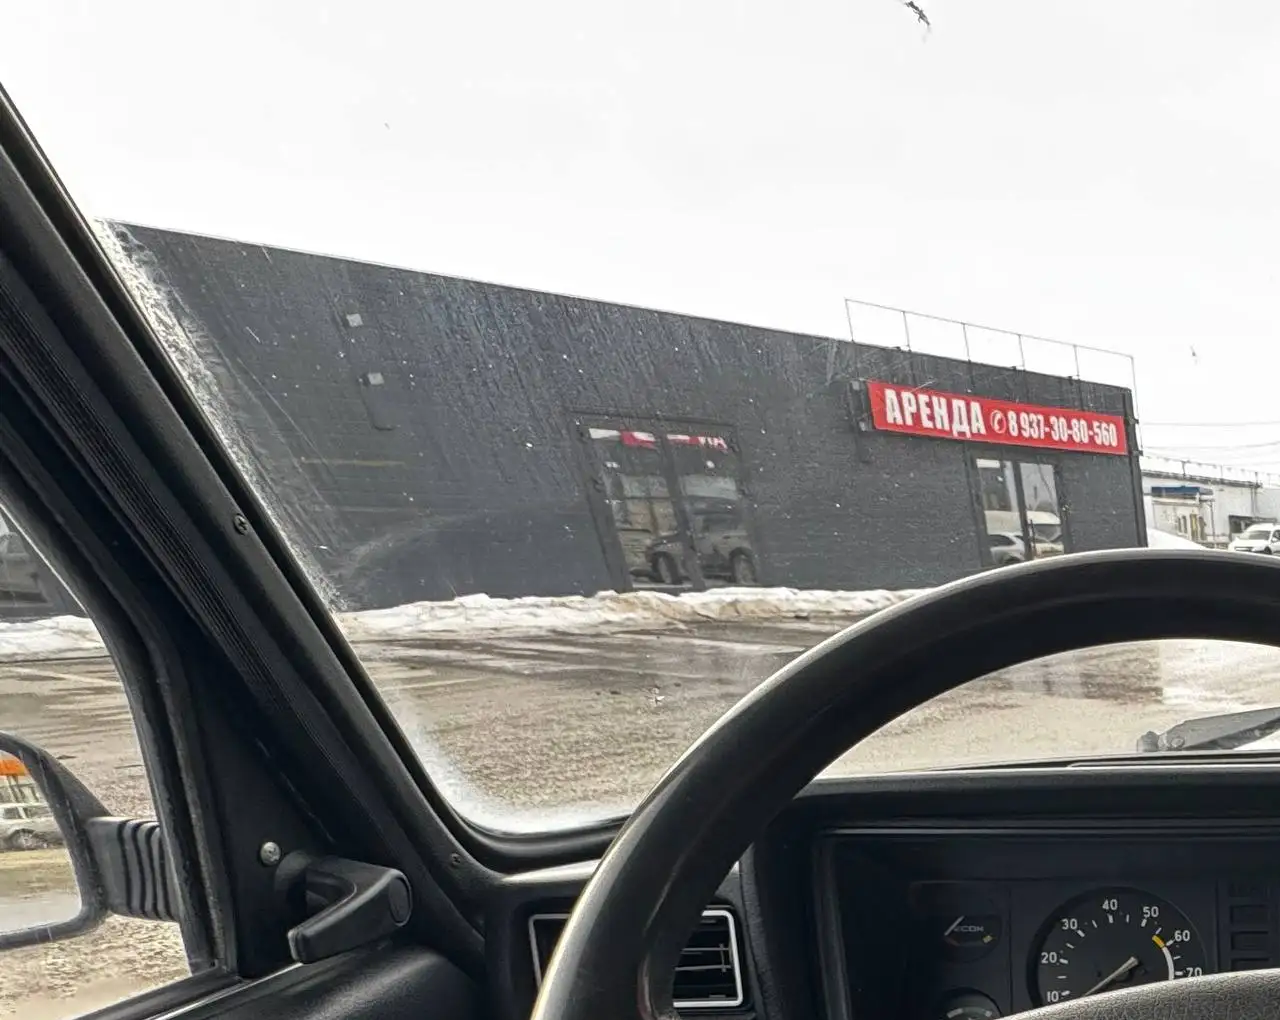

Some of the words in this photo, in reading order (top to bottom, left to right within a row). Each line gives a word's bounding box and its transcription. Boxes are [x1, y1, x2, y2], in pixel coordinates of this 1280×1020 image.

[884, 388, 987, 439] АРЕНДА
[1007, 409, 1018, 437] 8
[1020, 411, 1118, 447] 937-30-80-560
[1102, 899, 1118, 910] 40
[1143, 906, 1159, 918] 50
[1062, 918, 1078, 930] 30
[1174, 930, 1190, 941] 60
[1041, 952, 1057, 964] 20
[1186, 967, 1202, 978] 70
[1047, 991, 1059, 1002] 10
